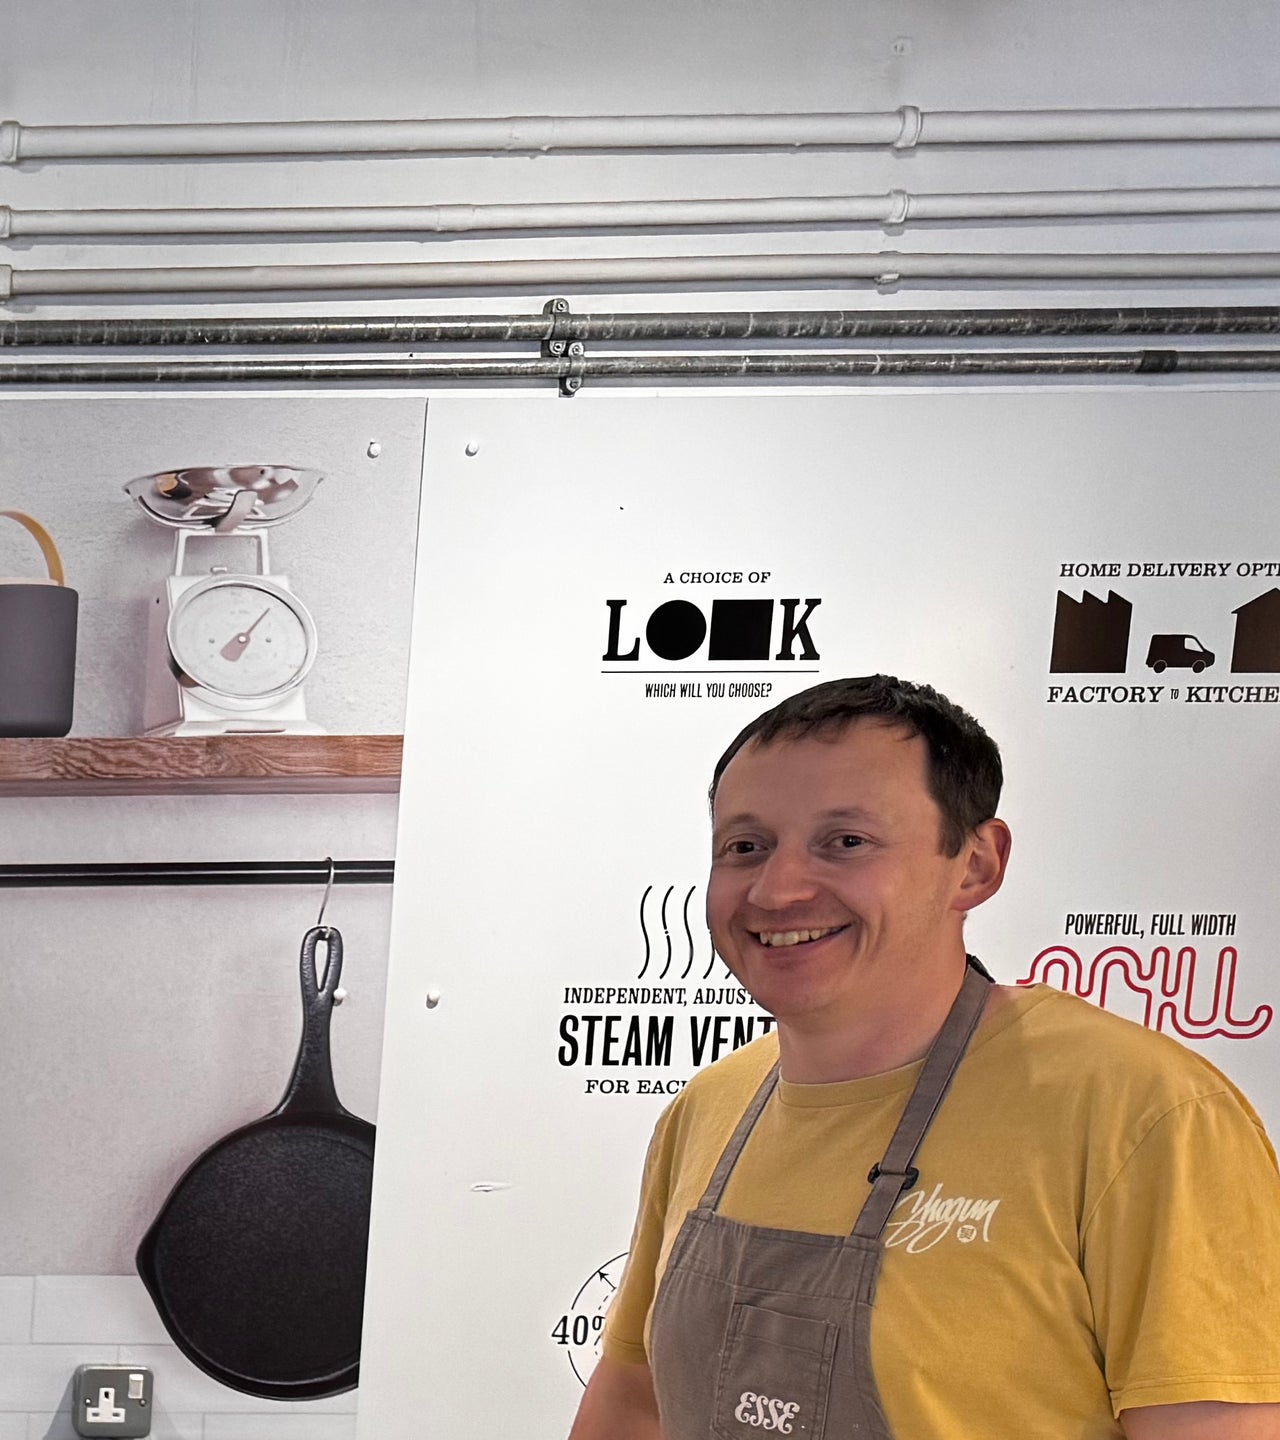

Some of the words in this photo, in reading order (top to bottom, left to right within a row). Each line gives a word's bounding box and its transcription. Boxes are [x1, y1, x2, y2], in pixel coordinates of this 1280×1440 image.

[663, 572, 675, 584] A
[679, 572, 744, 584] CHOICE
[748, 571, 771, 584] OF
[1059, 562, 1122, 577] HOME
[1126, 562, 1231, 577] DELIVERY
[645, 683, 676, 698] WHICH
[680, 683, 702, 698] WILL
[706, 683, 725, 698] YOU
[728, 683, 773, 698] CHOOSE?
[1047, 686, 1165, 703] FACTORY
[1185, 686, 1280, 703] KITCHE
[1064, 913, 1145, 939] POWERFUL,
[1150, 914, 1186, 936] FULL
[1191, 914, 1237, 936] WIDTH
[563, 987, 687, 1007] INDEPENDENT,
[558, 1014, 675, 1067] STEAM
[584, 1079, 630, 1094] FOR
[636, 1079, 687, 1094] EAC
[734, 1391, 801, 1435] ESSE
